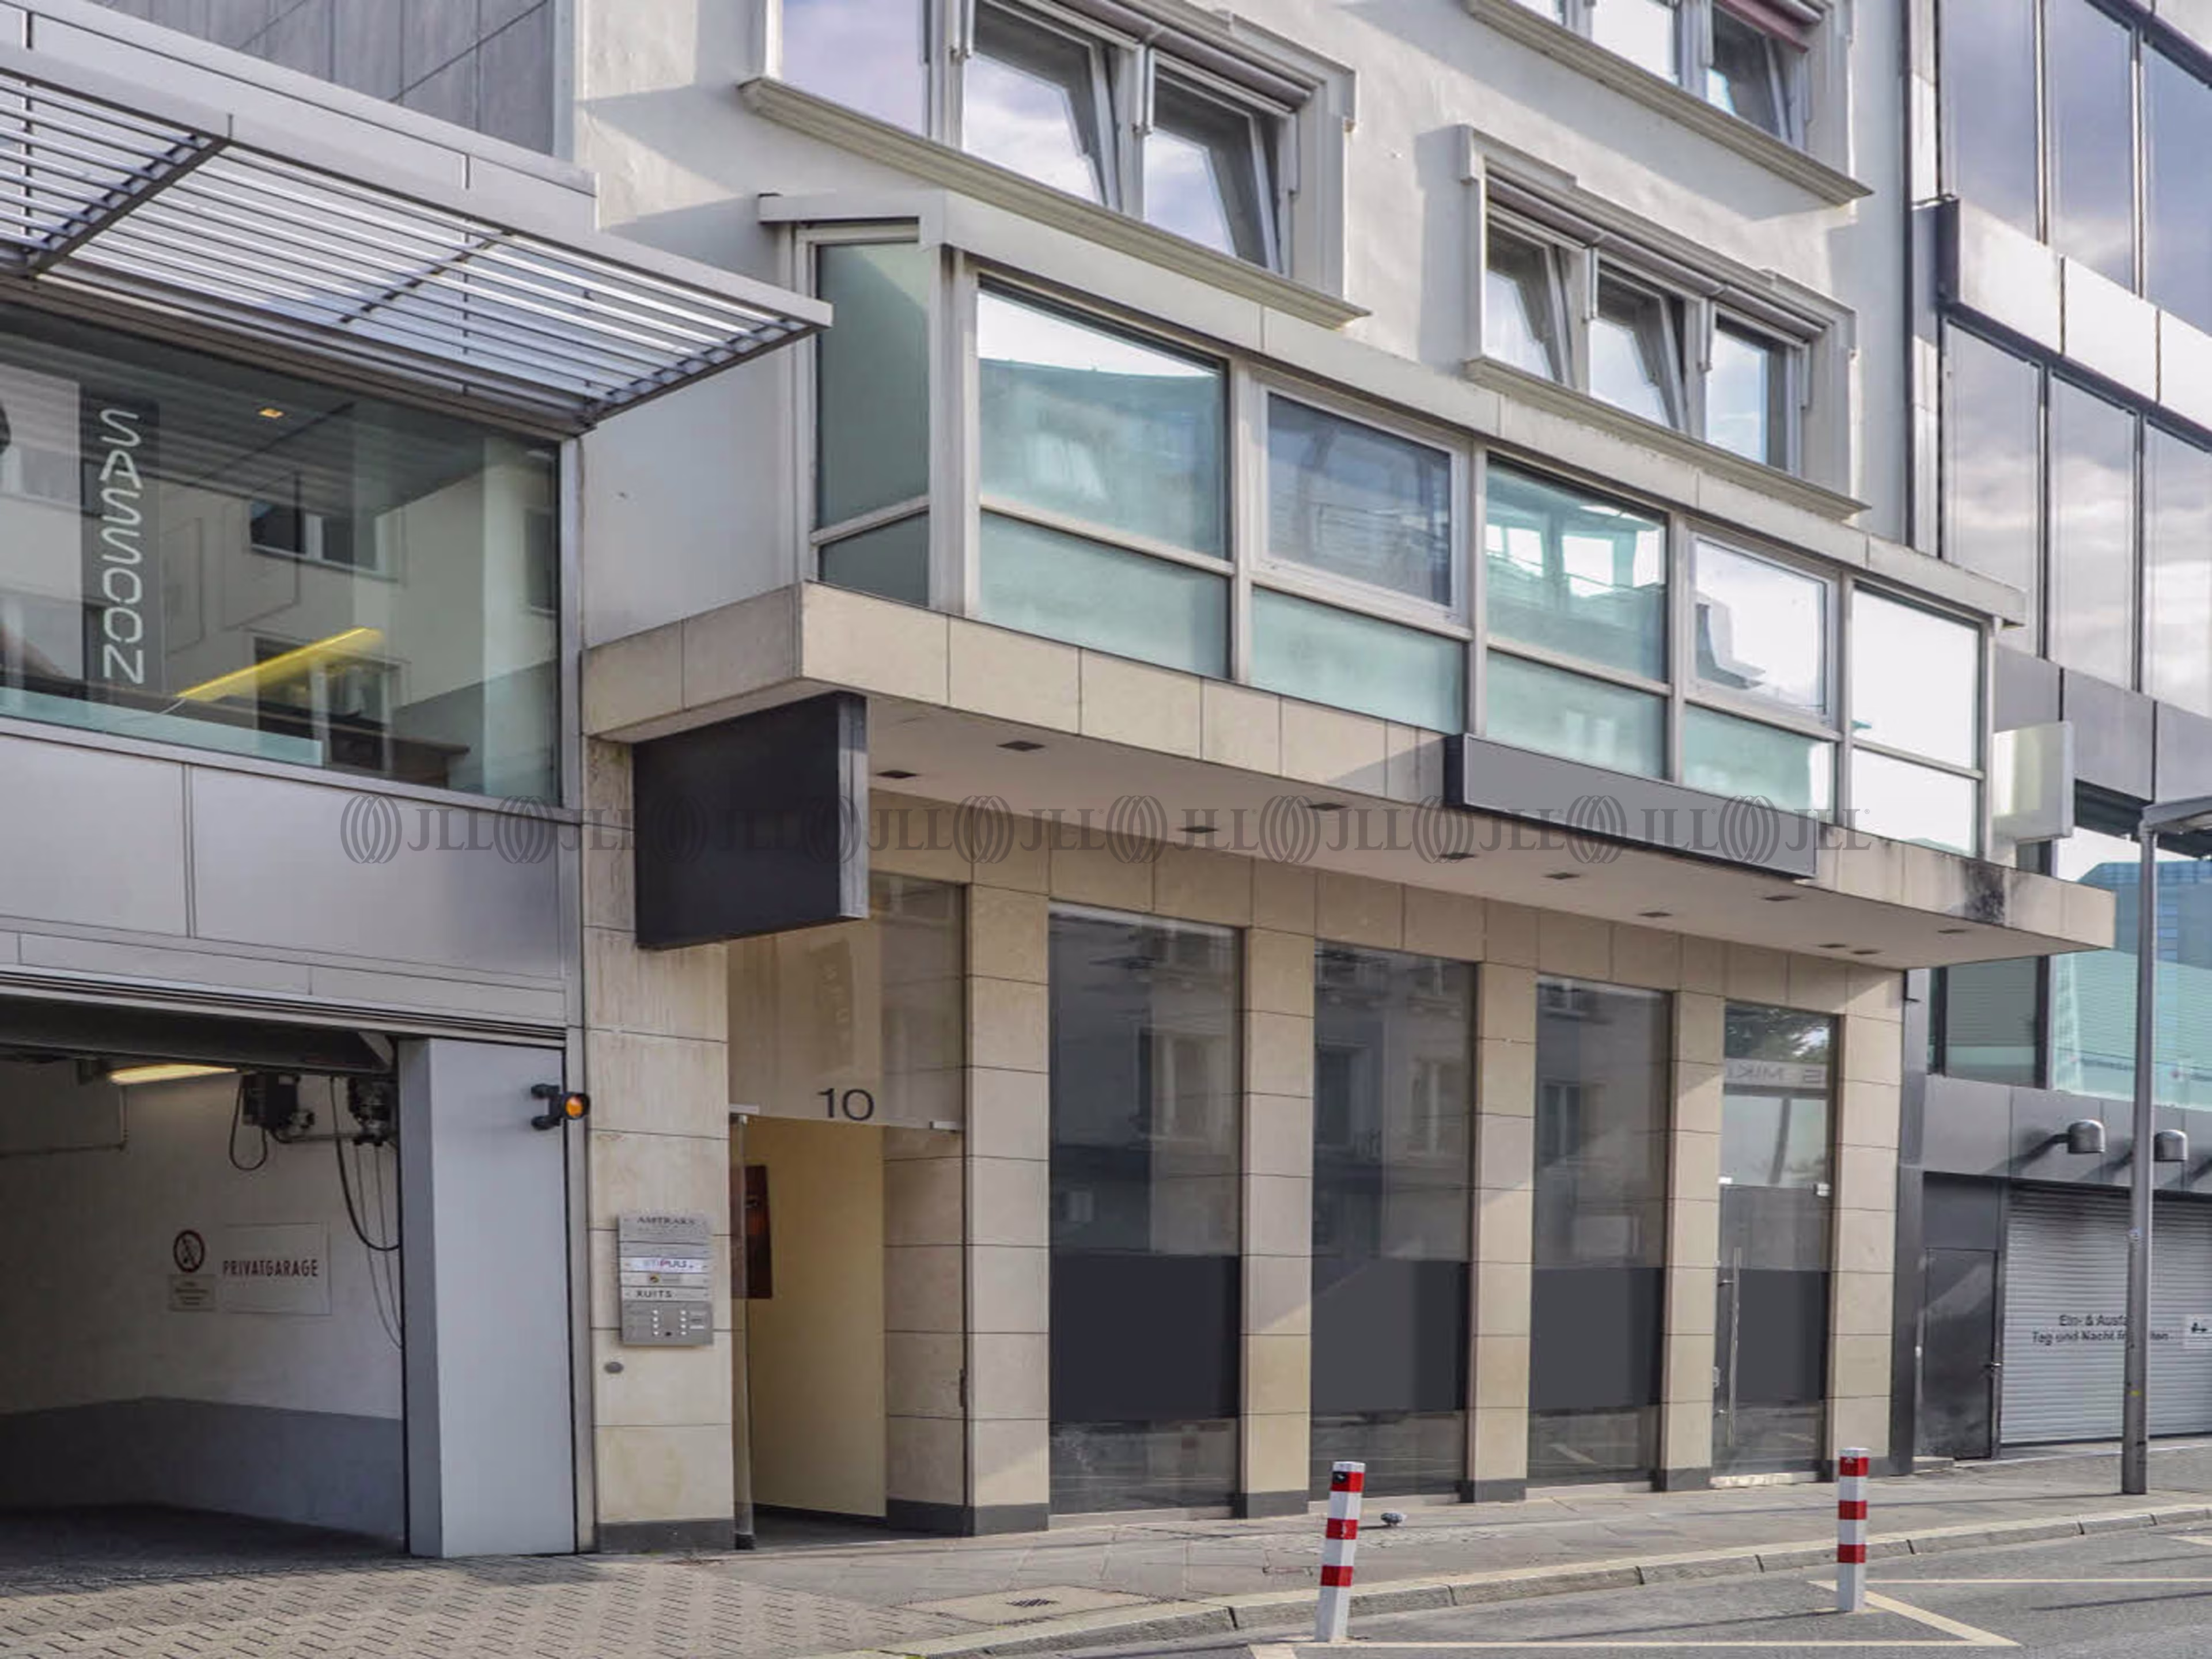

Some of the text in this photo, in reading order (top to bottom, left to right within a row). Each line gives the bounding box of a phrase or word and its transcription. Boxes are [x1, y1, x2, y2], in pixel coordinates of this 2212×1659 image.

[99, 409, 146, 684] SASSOON
[817, 1088, 874, 1121] 10
[223, 1259, 318, 1277] PRIVATGARAGE
[2032, 1331, 2052, 1346] Tag
